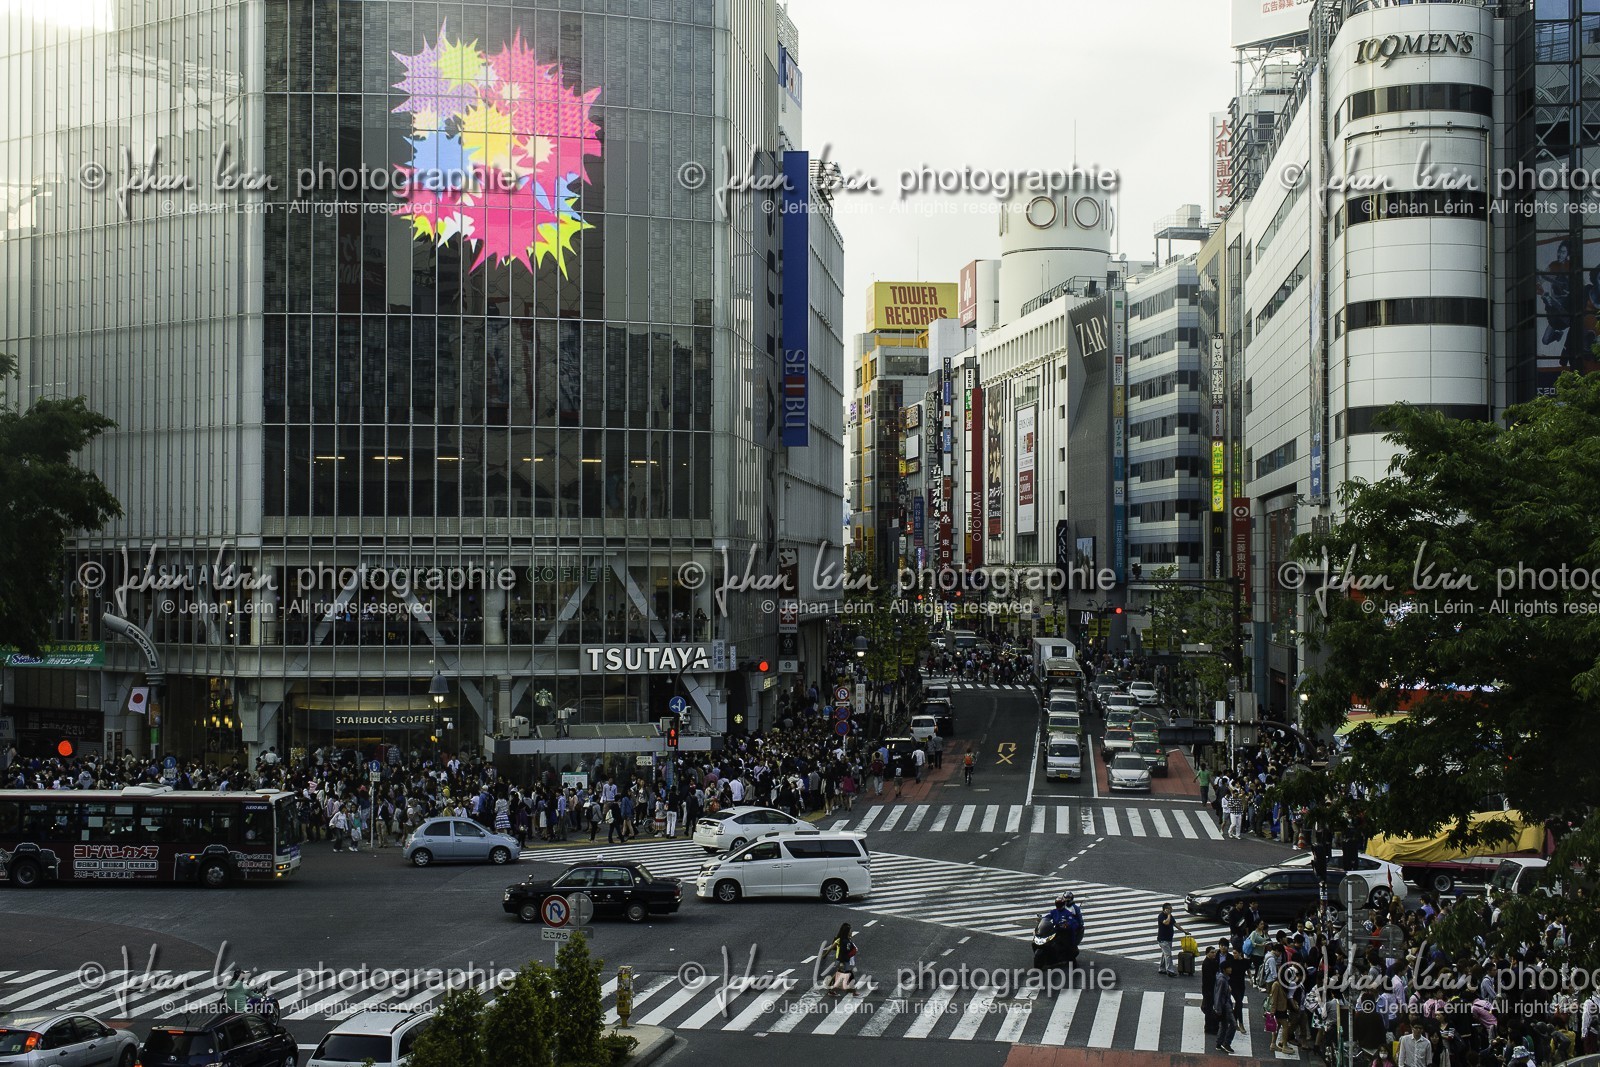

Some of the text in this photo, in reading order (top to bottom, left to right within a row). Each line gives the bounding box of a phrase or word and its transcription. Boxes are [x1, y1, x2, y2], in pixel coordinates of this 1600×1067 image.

[1216, 119, 1231, 198] 大和証券
[890, 286, 938, 305] TOWER
[885, 306, 948, 325] RECORDS
[785, 349, 806, 428] SEIBU
[926, 392, 936, 453] KARAOKE
[1058, 527, 1066, 564] ZARA
[587, 647, 710, 671] TSUTAYA
[336, 716, 398, 724] STARBUCKS
[74, 845, 159, 859] ヨドバシカメラ
[544, 932, 568, 940] ここから
